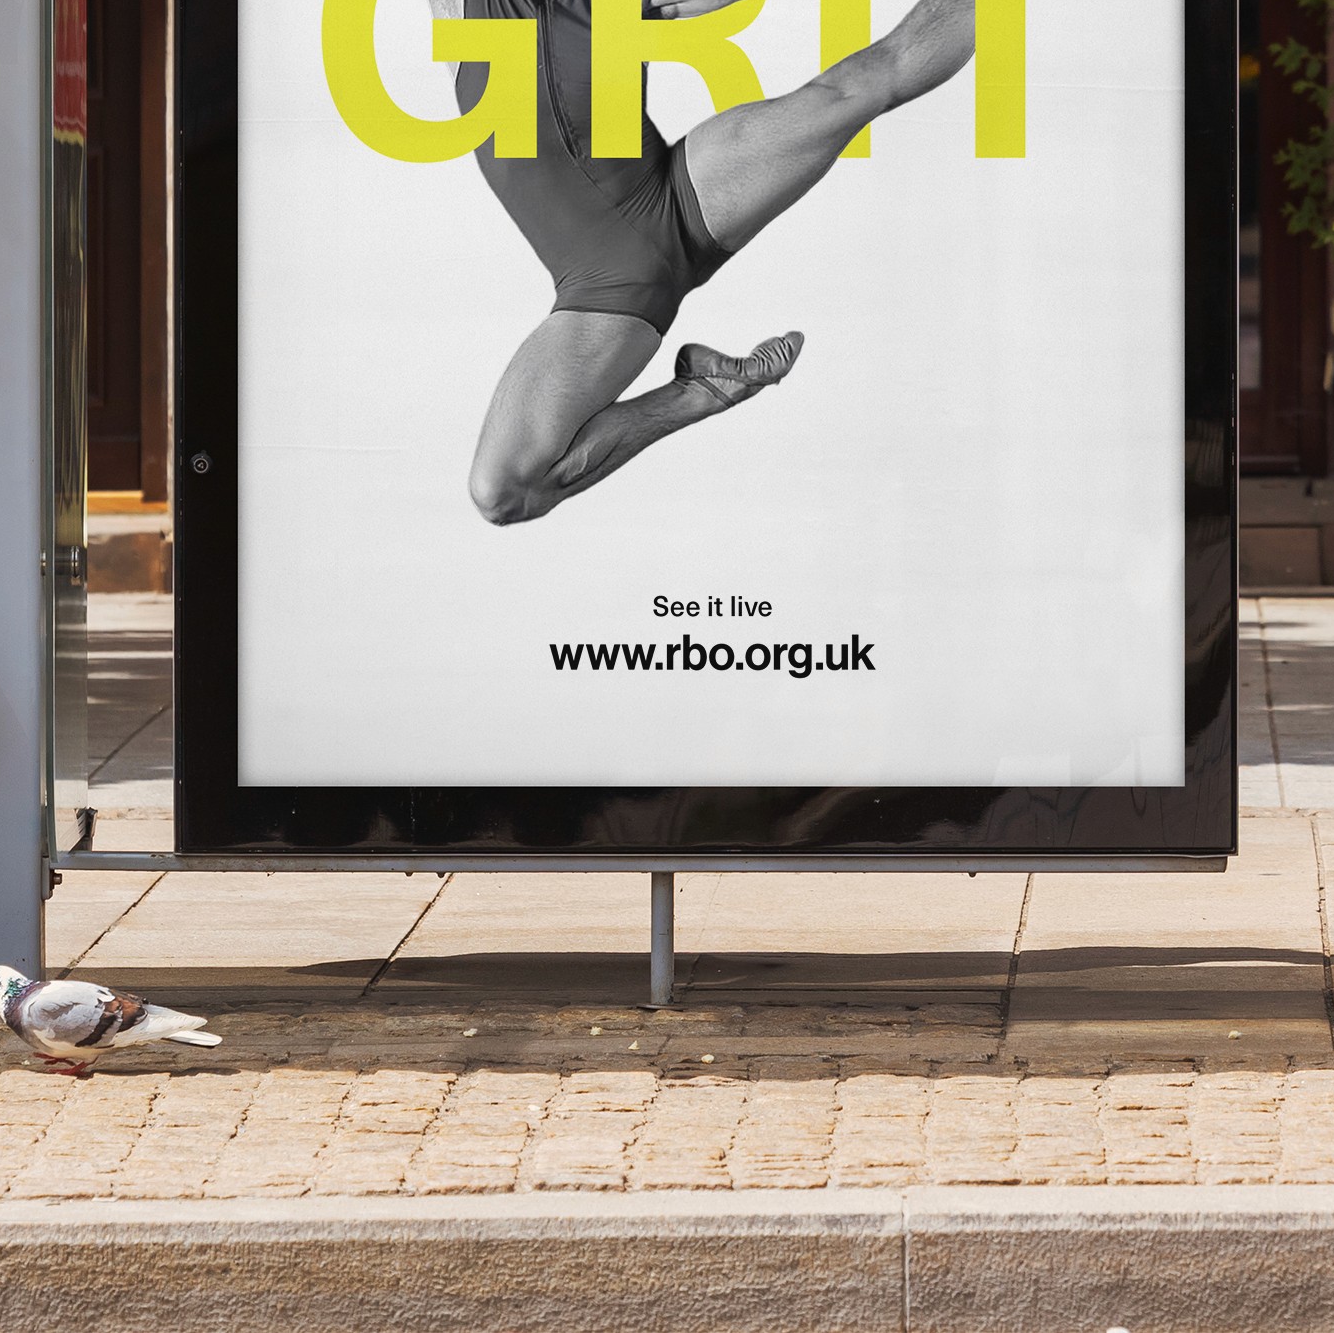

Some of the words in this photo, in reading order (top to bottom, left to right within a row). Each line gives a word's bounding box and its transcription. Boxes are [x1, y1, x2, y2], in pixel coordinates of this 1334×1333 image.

[652, 595, 701, 618] See
[708, 595, 724, 618] it
[730, 595, 773, 618] live
[549, 633, 877, 679] www.rbo.org.uk
